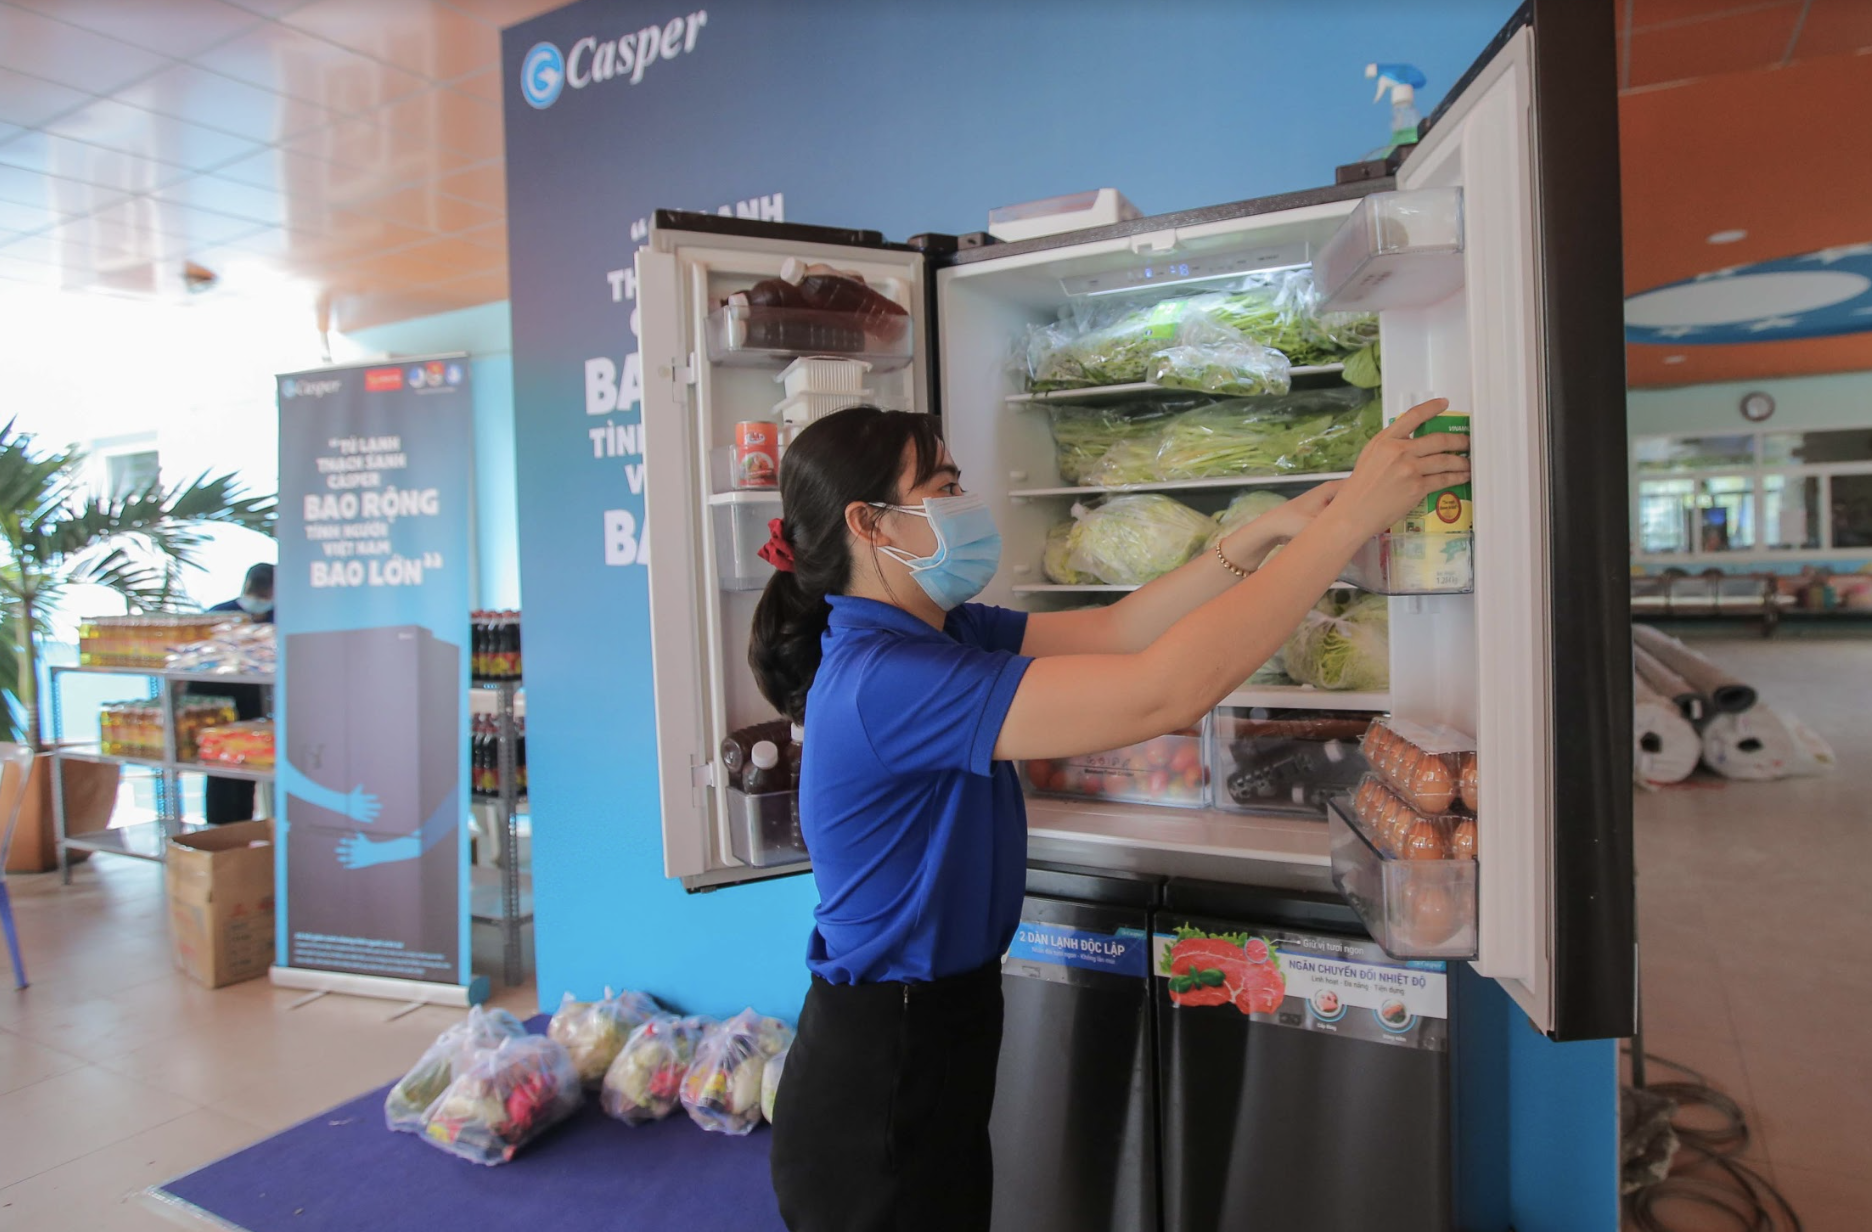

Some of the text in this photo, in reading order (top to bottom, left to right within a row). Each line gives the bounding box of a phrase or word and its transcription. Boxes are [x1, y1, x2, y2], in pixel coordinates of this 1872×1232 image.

[566, 9, 708, 90] Casper
[584, 352, 642, 416] BA
[326, 472, 380, 490] CASPER
[303, 485, 439, 523] BAO RỘNG
[356, 540, 391, 555] NAM
[310, 560, 364, 588] BAO
[1019, 931, 1125, 958] 2 DÀN LẠNH ĐỘC LẬP
[1303, 939, 1364, 956] Giữ vị tươi ngon
[1289, 959, 1426, 989] NGĂN CHUYỂN ĐỔI NHIỆT ĐỘ
[1311, 974, 1324, 983] Linh
[1374, 983, 1387, 993] Tiện
